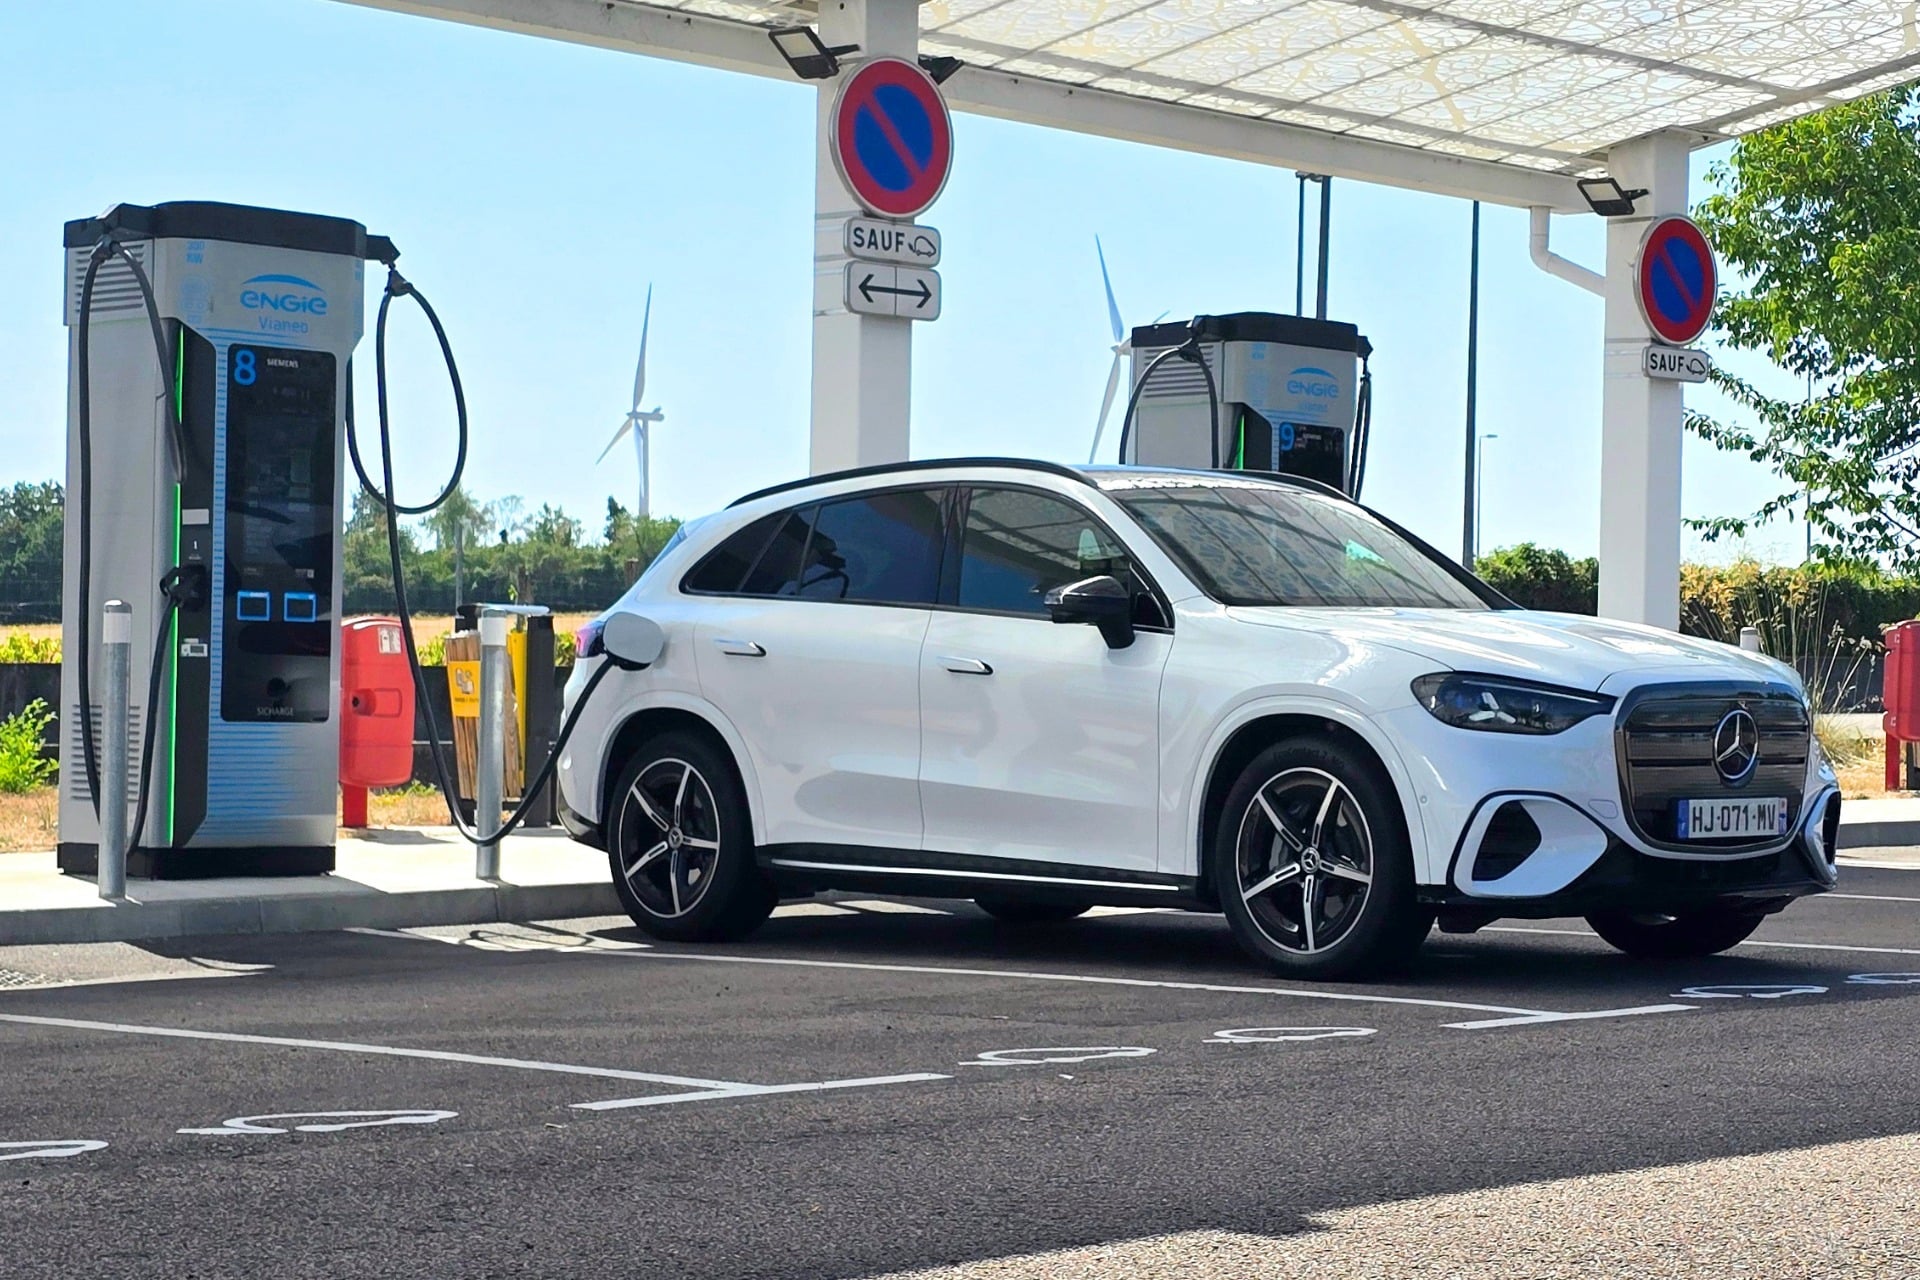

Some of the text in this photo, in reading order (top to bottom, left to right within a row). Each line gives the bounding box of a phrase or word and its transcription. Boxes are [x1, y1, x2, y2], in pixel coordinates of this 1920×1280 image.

[853, 227, 905, 252] SAUF
[259, 316, 309, 333] Vianeo
[234, 349, 256, 385] 8
[267, 358, 299, 368] SIEMENS
[1650, 353, 1684, 372] SAUF
[1280, 423, 1295, 451] 9
[257, 707, 294, 717] SICHARGE
